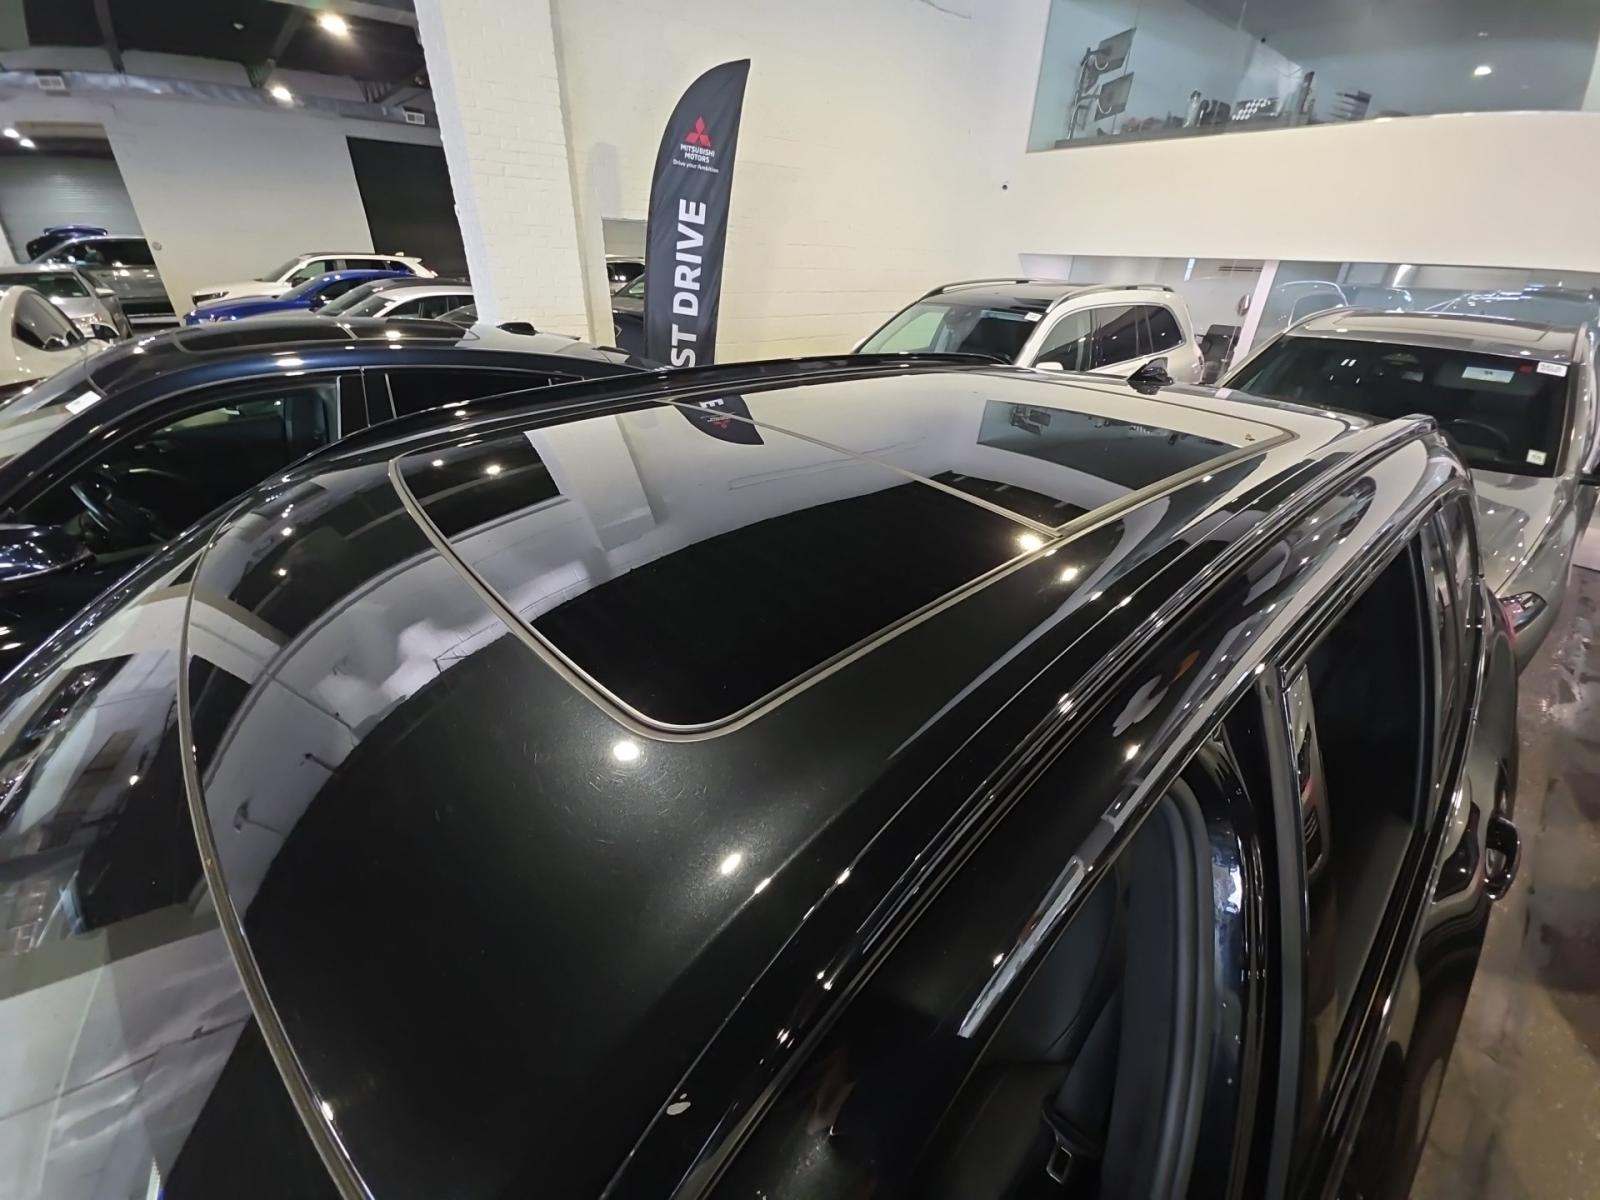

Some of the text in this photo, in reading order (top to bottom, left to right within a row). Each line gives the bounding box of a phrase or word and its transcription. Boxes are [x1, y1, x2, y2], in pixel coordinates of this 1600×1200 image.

[680, 143, 715, 157] MITSUBISHI
[672, 158, 686, 167] Drive
[684, 152, 710, 163] MOTORS
[672, 198, 707, 317] DRIVE
